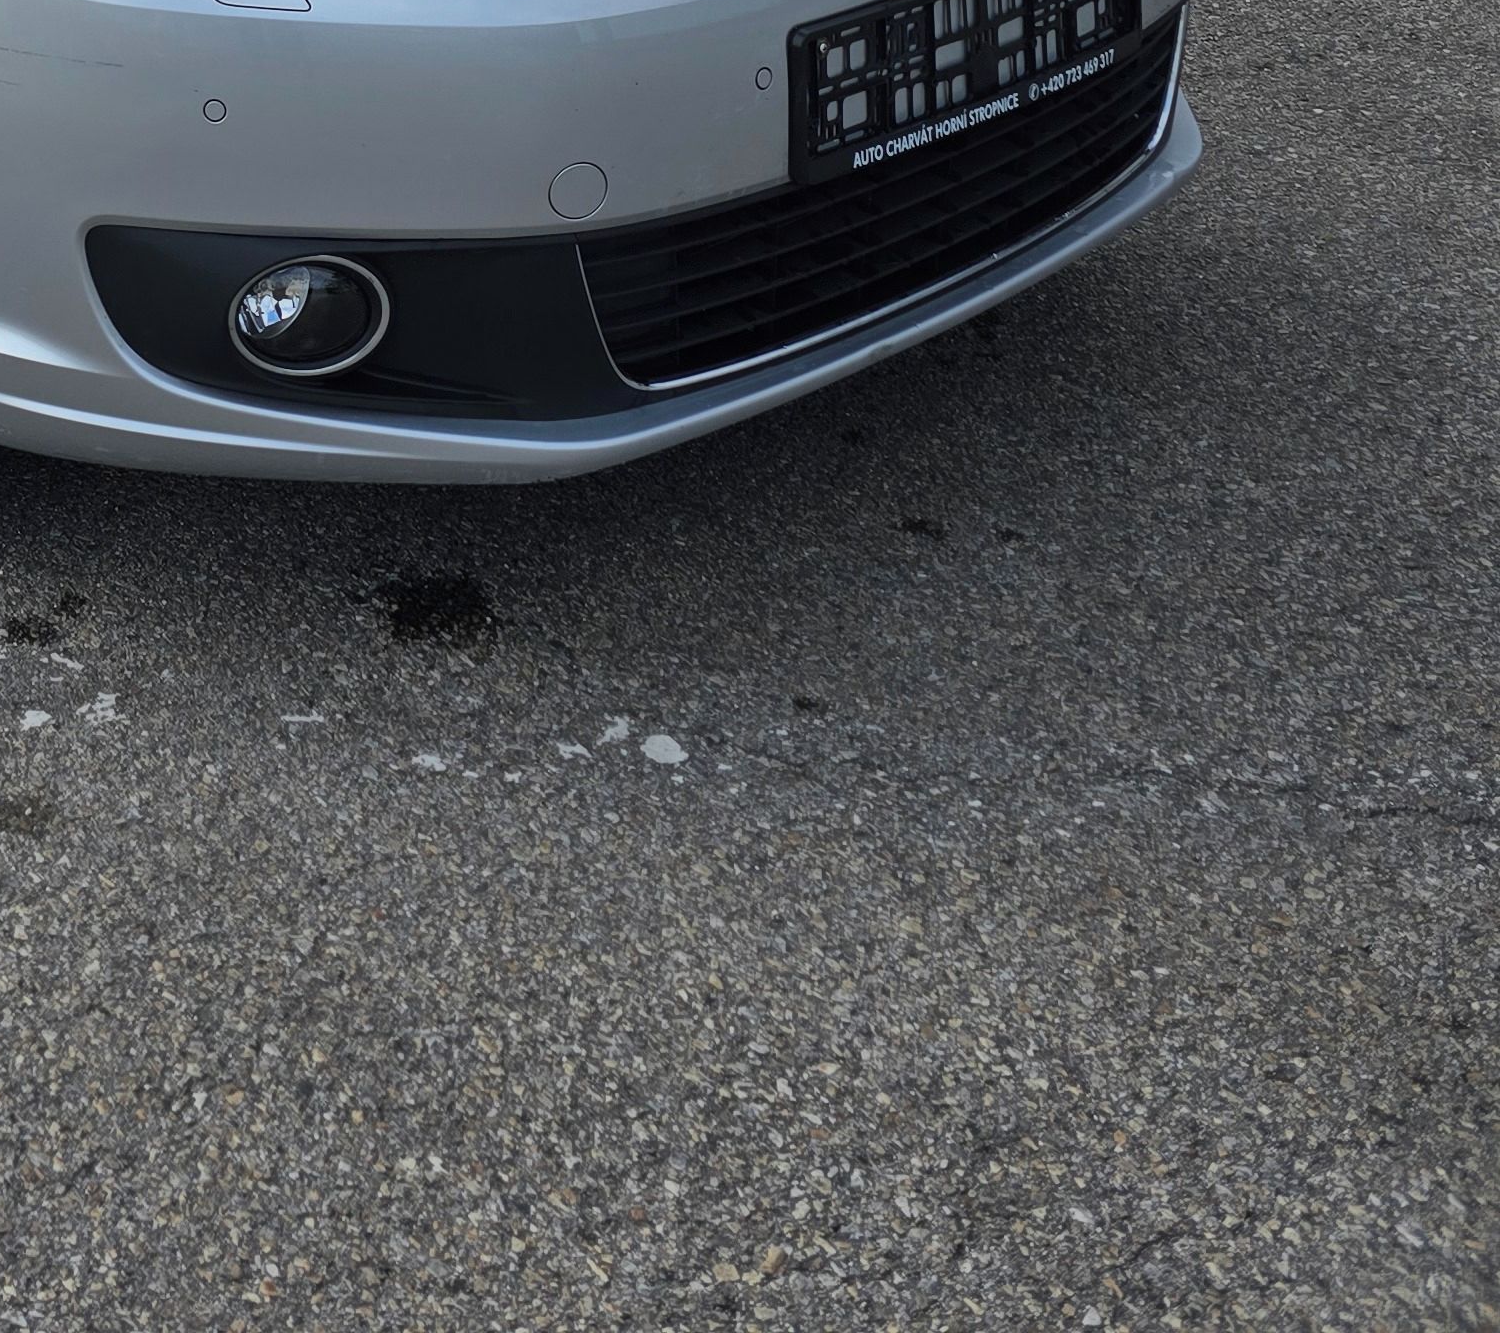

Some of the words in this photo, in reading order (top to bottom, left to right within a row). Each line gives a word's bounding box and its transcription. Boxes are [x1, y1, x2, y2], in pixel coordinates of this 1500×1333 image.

[853, 144, 884, 169] AUTO
[886, 124, 934, 157] CHARVÁT
[935, 108, 968, 139] HORNÍ
[969, 93, 1020, 126] STROPNICE
[1040, 73, 1065, 96] +420
[1065, 65, 1082, 85] 723
[1083, 57, 1098, 76] 469
[1099, 48, 1115, 69] 317
